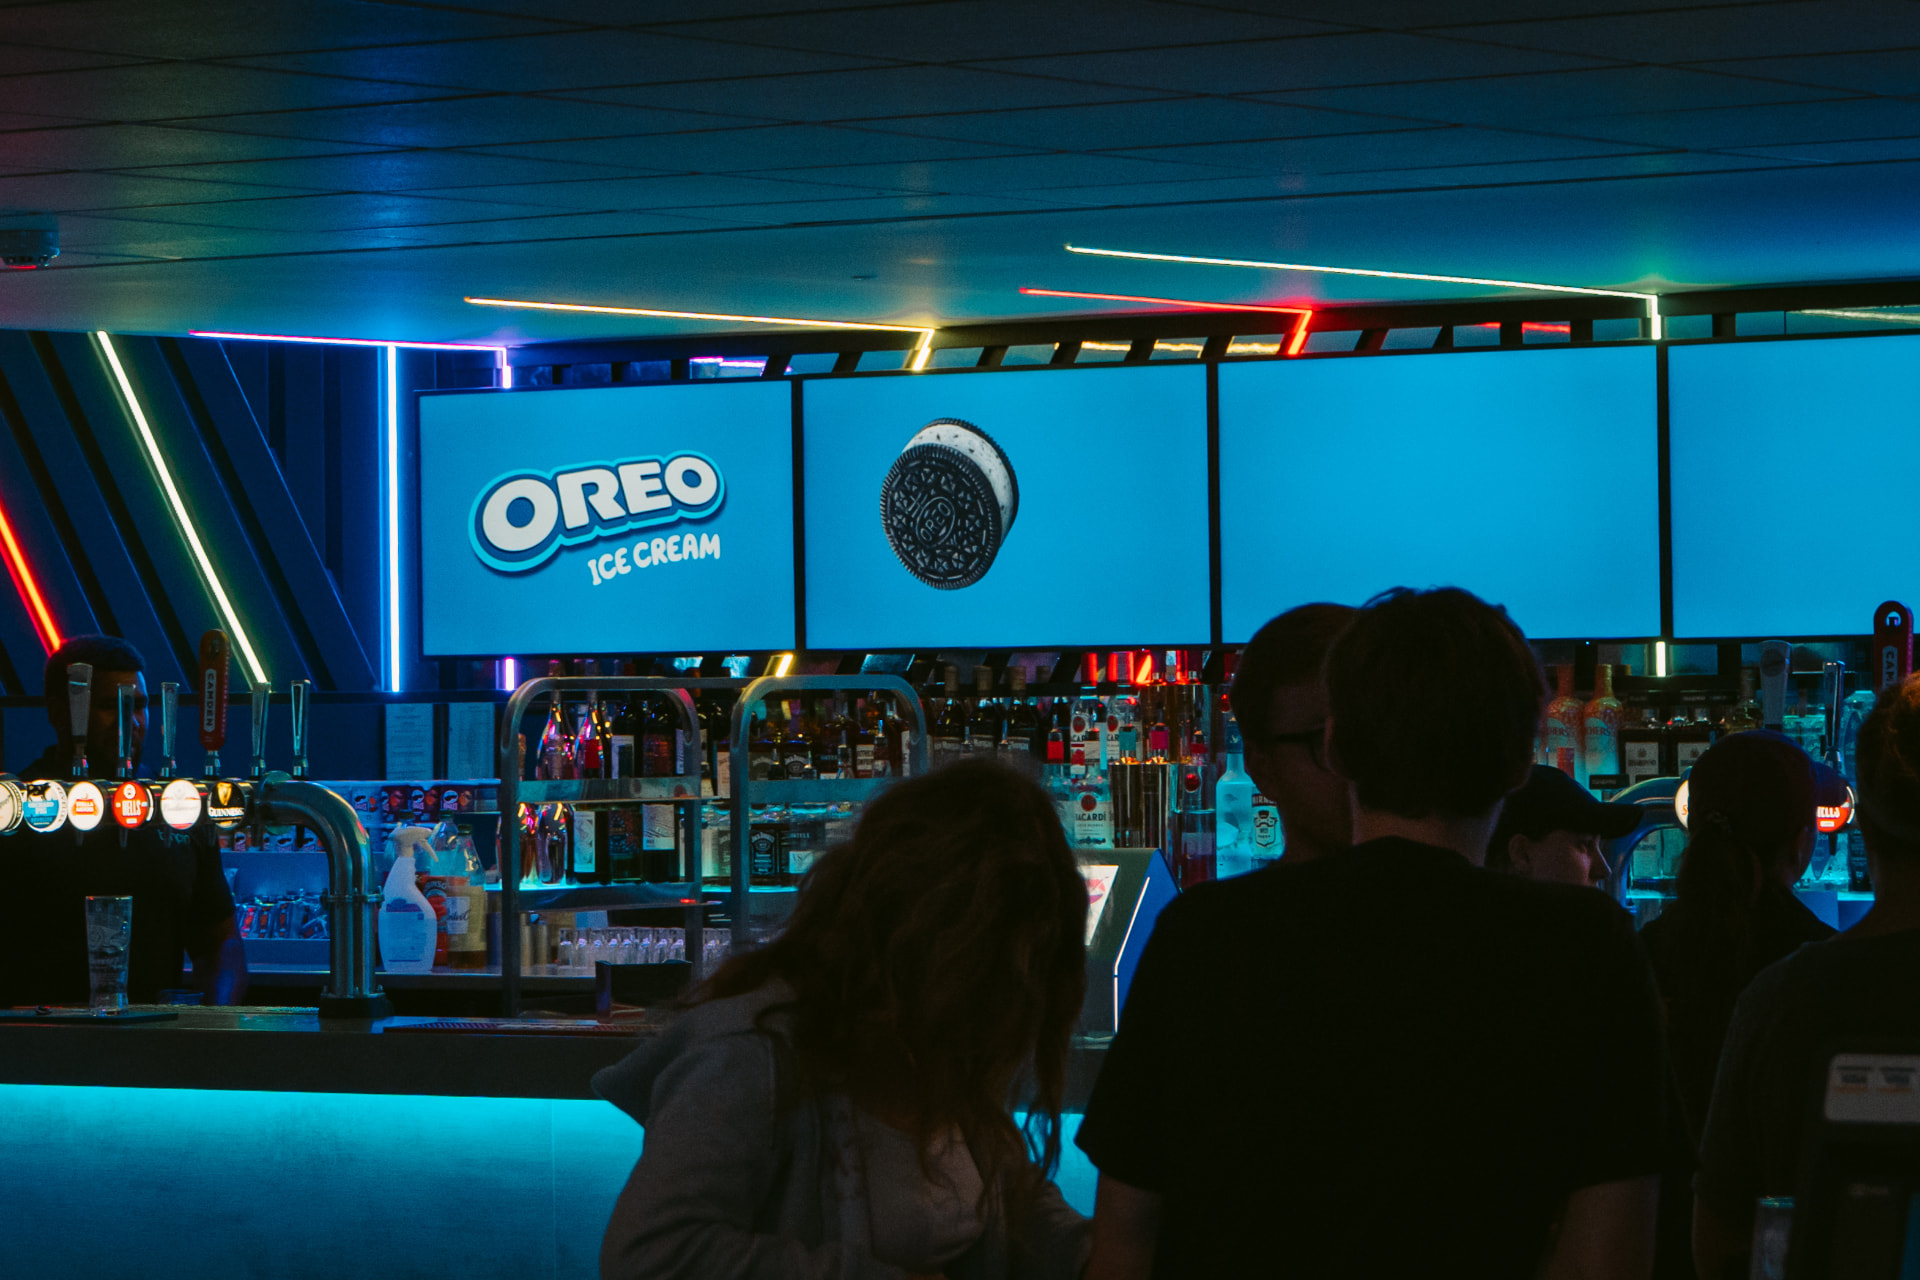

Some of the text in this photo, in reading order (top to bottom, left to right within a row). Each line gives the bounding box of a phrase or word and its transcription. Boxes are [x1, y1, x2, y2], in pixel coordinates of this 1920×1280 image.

[482, 456, 718, 552] OREO
[587, 532, 721, 586] ICE CREAM
[206, 673, 214, 727] CAMDEN
[122, 800, 141, 816] HELLS
[208, 807, 244, 817] GUINNESS
